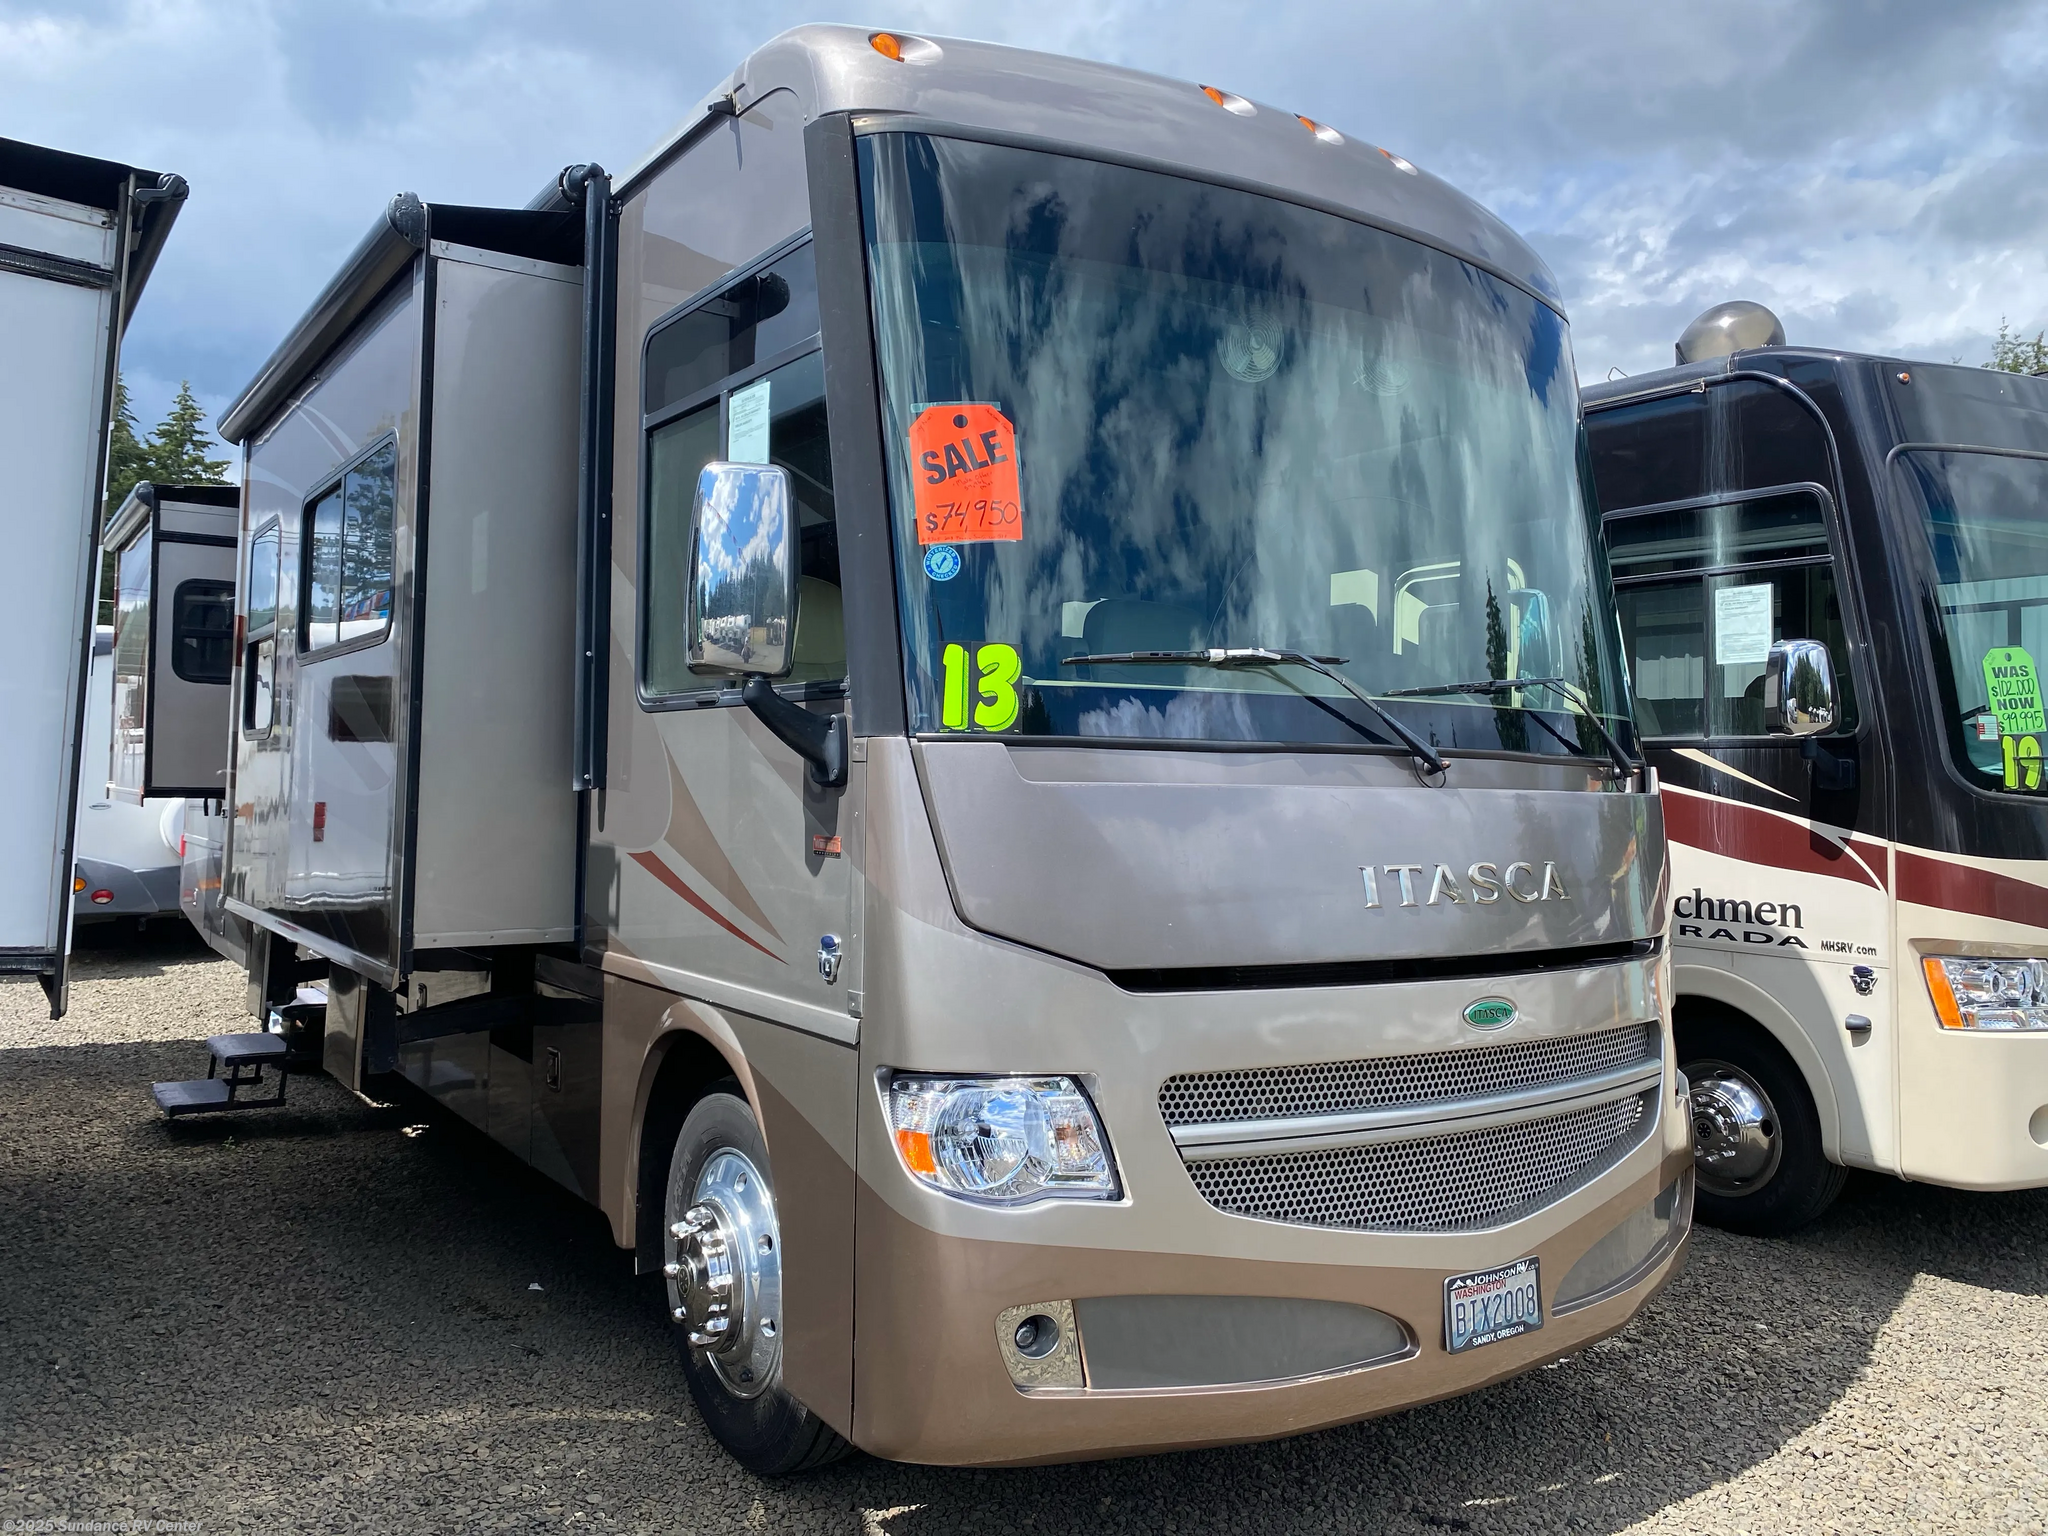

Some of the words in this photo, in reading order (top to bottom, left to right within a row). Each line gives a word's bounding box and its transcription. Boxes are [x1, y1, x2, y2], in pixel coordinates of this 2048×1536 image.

[919, 429, 1009, 485] SALE
[925, 499, 1019, 533] $74,950
[925, 546, 956, 566] WINTERIZED
[931, 564, 958, 579] CHECKED
[1991, 665, 2030, 679] WAS
[942, 643, 1022, 732] 13
[1996, 696, 2035, 711] NOW
[2001, 734, 2043, 790] 19
[1356, 860, 1572, 909] ITASCA
[1674, 887, 1804, 929] chmen
[1679, 924, 1809, 949] RADA
[1820, 940, 1878, 957] MHSRV.com
[1473, 1007, 1508, 1020] ITASCA
[1454, 1279, 1507, 1300] WASHINGTON
[1455, 1283, 1536, 1338] BIX2008
[1472, 1332, 1497, 1346] SANDY,
[1496, 1324, 1525, 1340] OREGON
